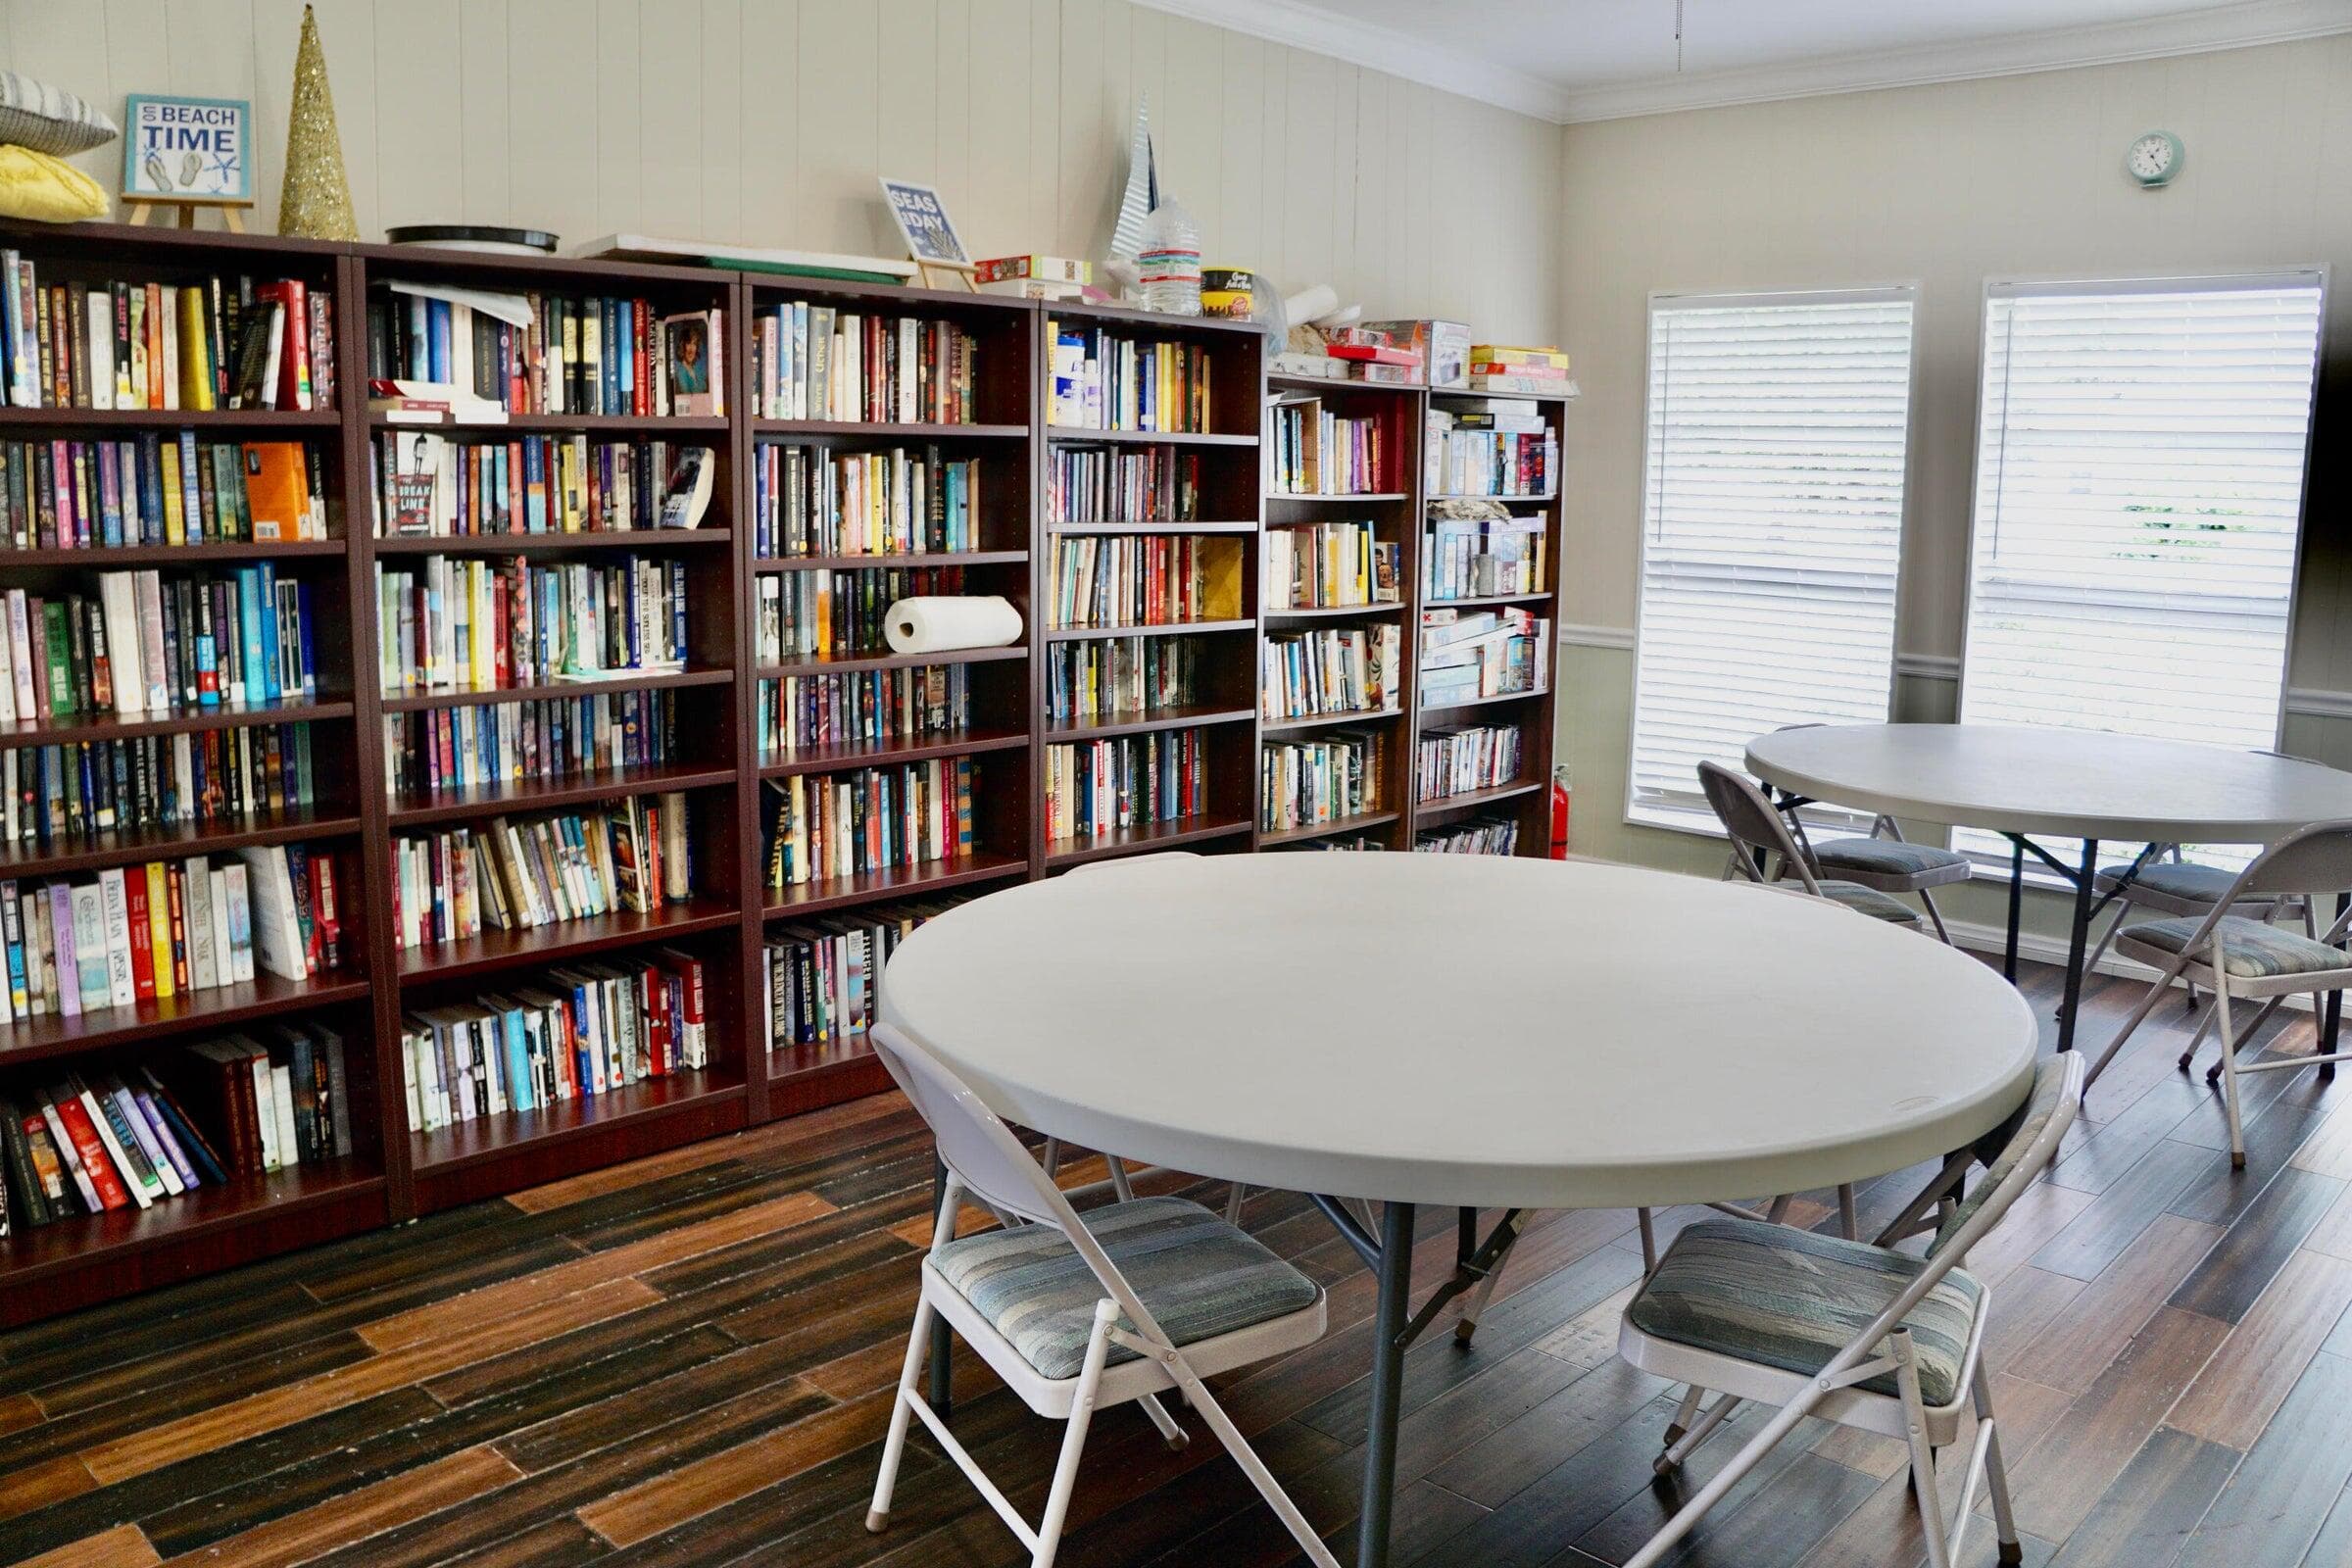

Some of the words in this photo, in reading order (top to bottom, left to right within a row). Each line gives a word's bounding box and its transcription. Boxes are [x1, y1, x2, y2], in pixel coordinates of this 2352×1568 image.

[142, 106, 157, 122] ON
[162, 106, 236, 125] BEACH
[142, 125, 236, 153] TIME
[890, 190, 938, 214] SEAS
[907, 213, 944, 231] DAY
[398, 485, 431, 497] BREAK
[400, 498, 425, 511] LINE
[200, 585, 209, 605] SEAN
